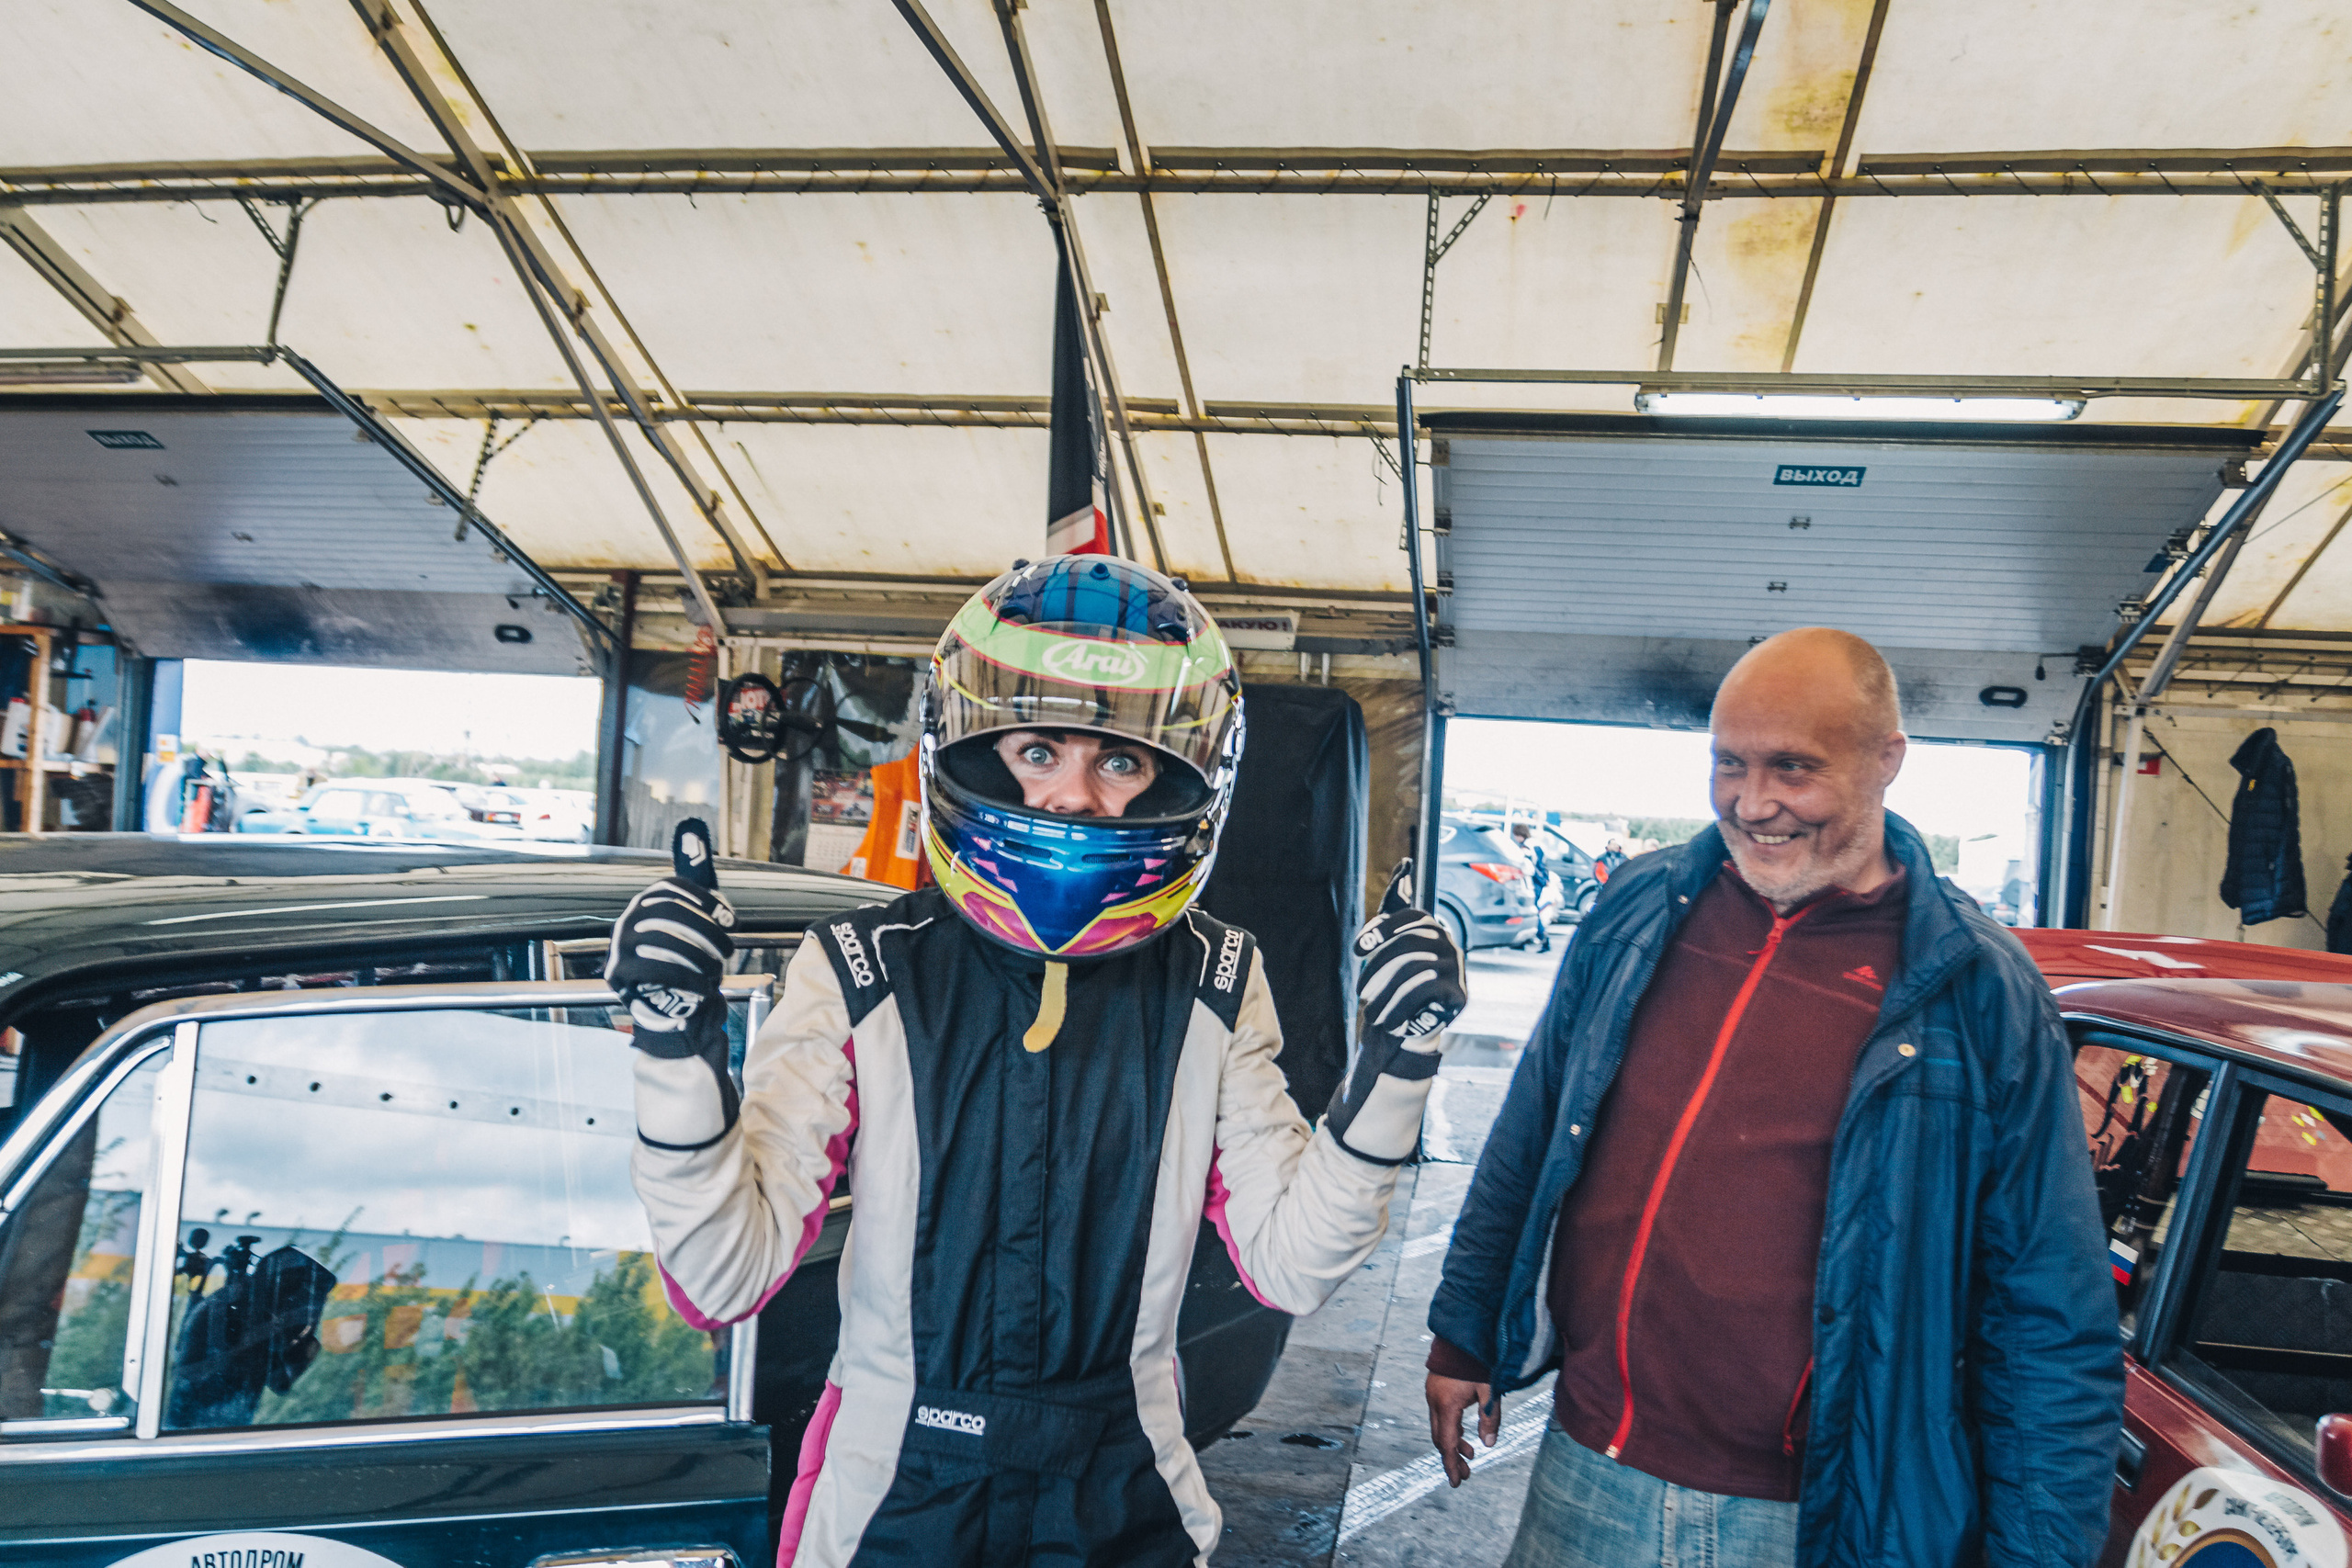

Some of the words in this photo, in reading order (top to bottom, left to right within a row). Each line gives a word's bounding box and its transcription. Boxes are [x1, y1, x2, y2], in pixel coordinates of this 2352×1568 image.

[1779, 468, 1859, 486] ВЫХОД
[1049, 642, 1133, 676] Arai
[830, 922, 875, 987] sparco
[1214, 929, 1244, 993] sparco
[916, 1404, 986, 1435] sparco
